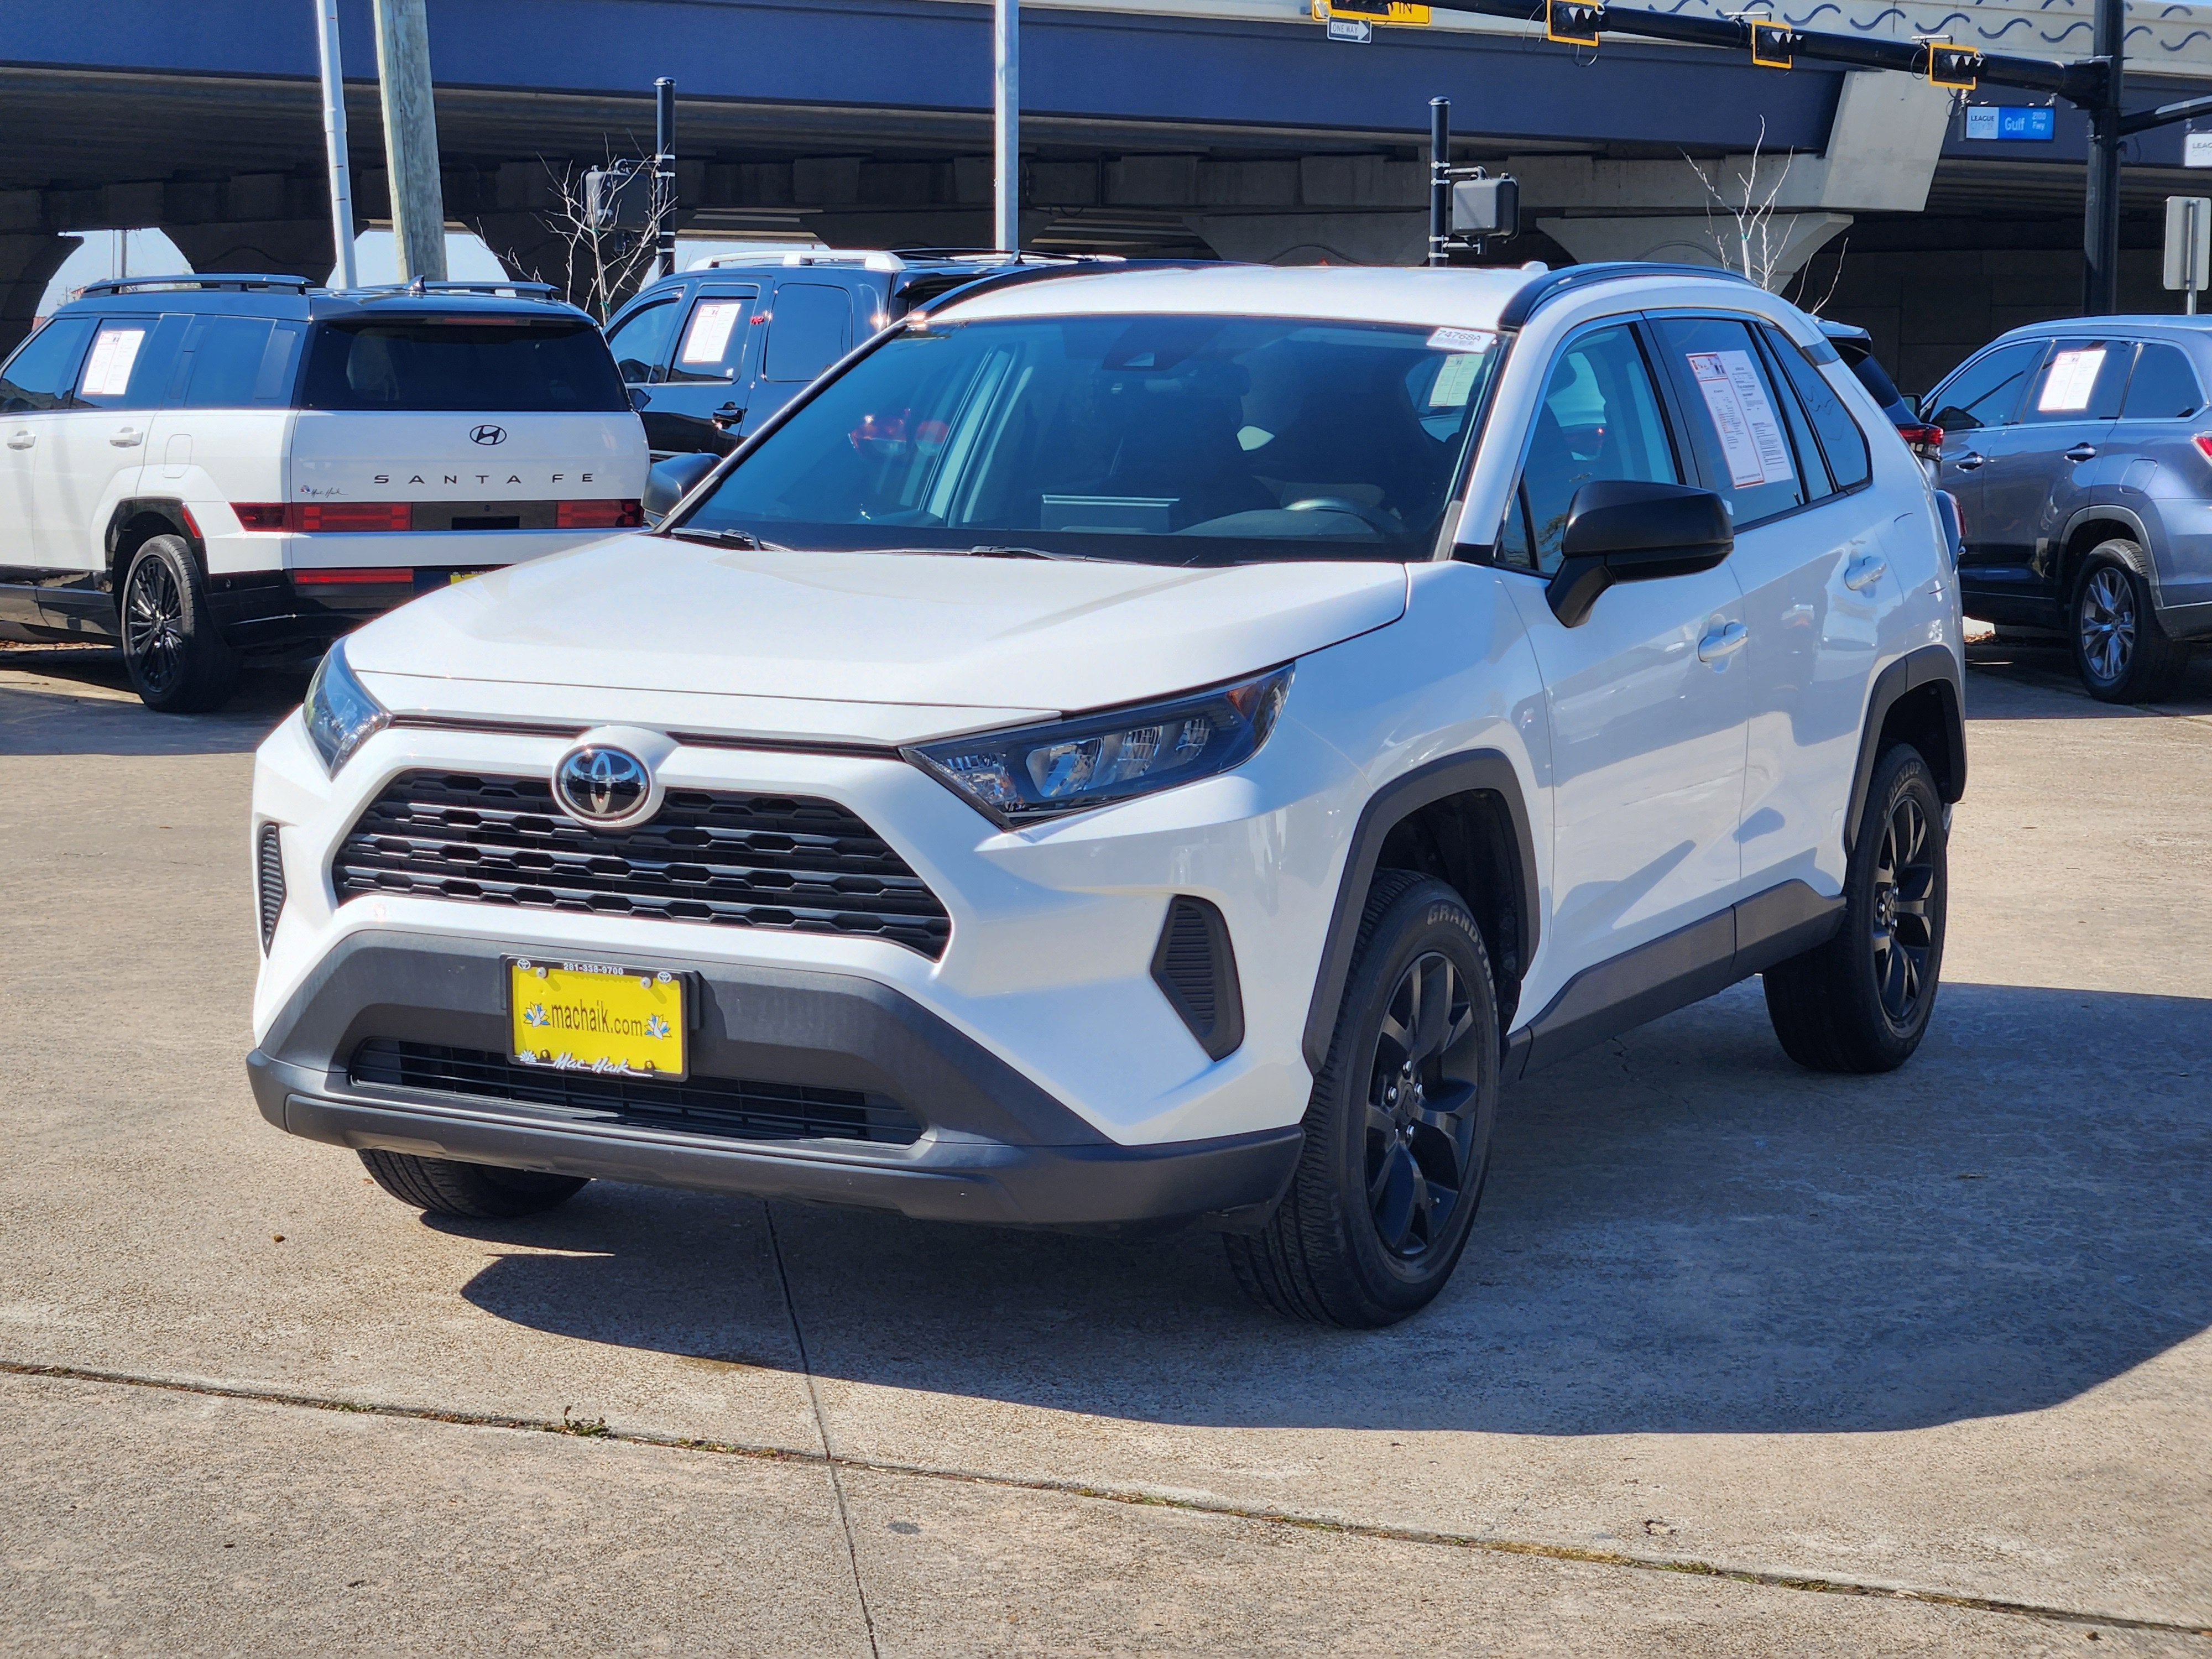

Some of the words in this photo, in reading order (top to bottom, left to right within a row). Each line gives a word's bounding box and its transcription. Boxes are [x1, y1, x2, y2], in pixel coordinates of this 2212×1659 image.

[1333, 24, 1344, 33] ONE
[1346, 25, 1358, 34] WAY
[2005, 117, 2025, 131] Gulf
[374, 474, 521, 484] SANTA
[551, 473, 593, 483] FE
[564, 962, 624, 975] 281-338-9700
[551, 999, 644, 1037] machaik.com
[552, 1052, 589, 1070] Mac
